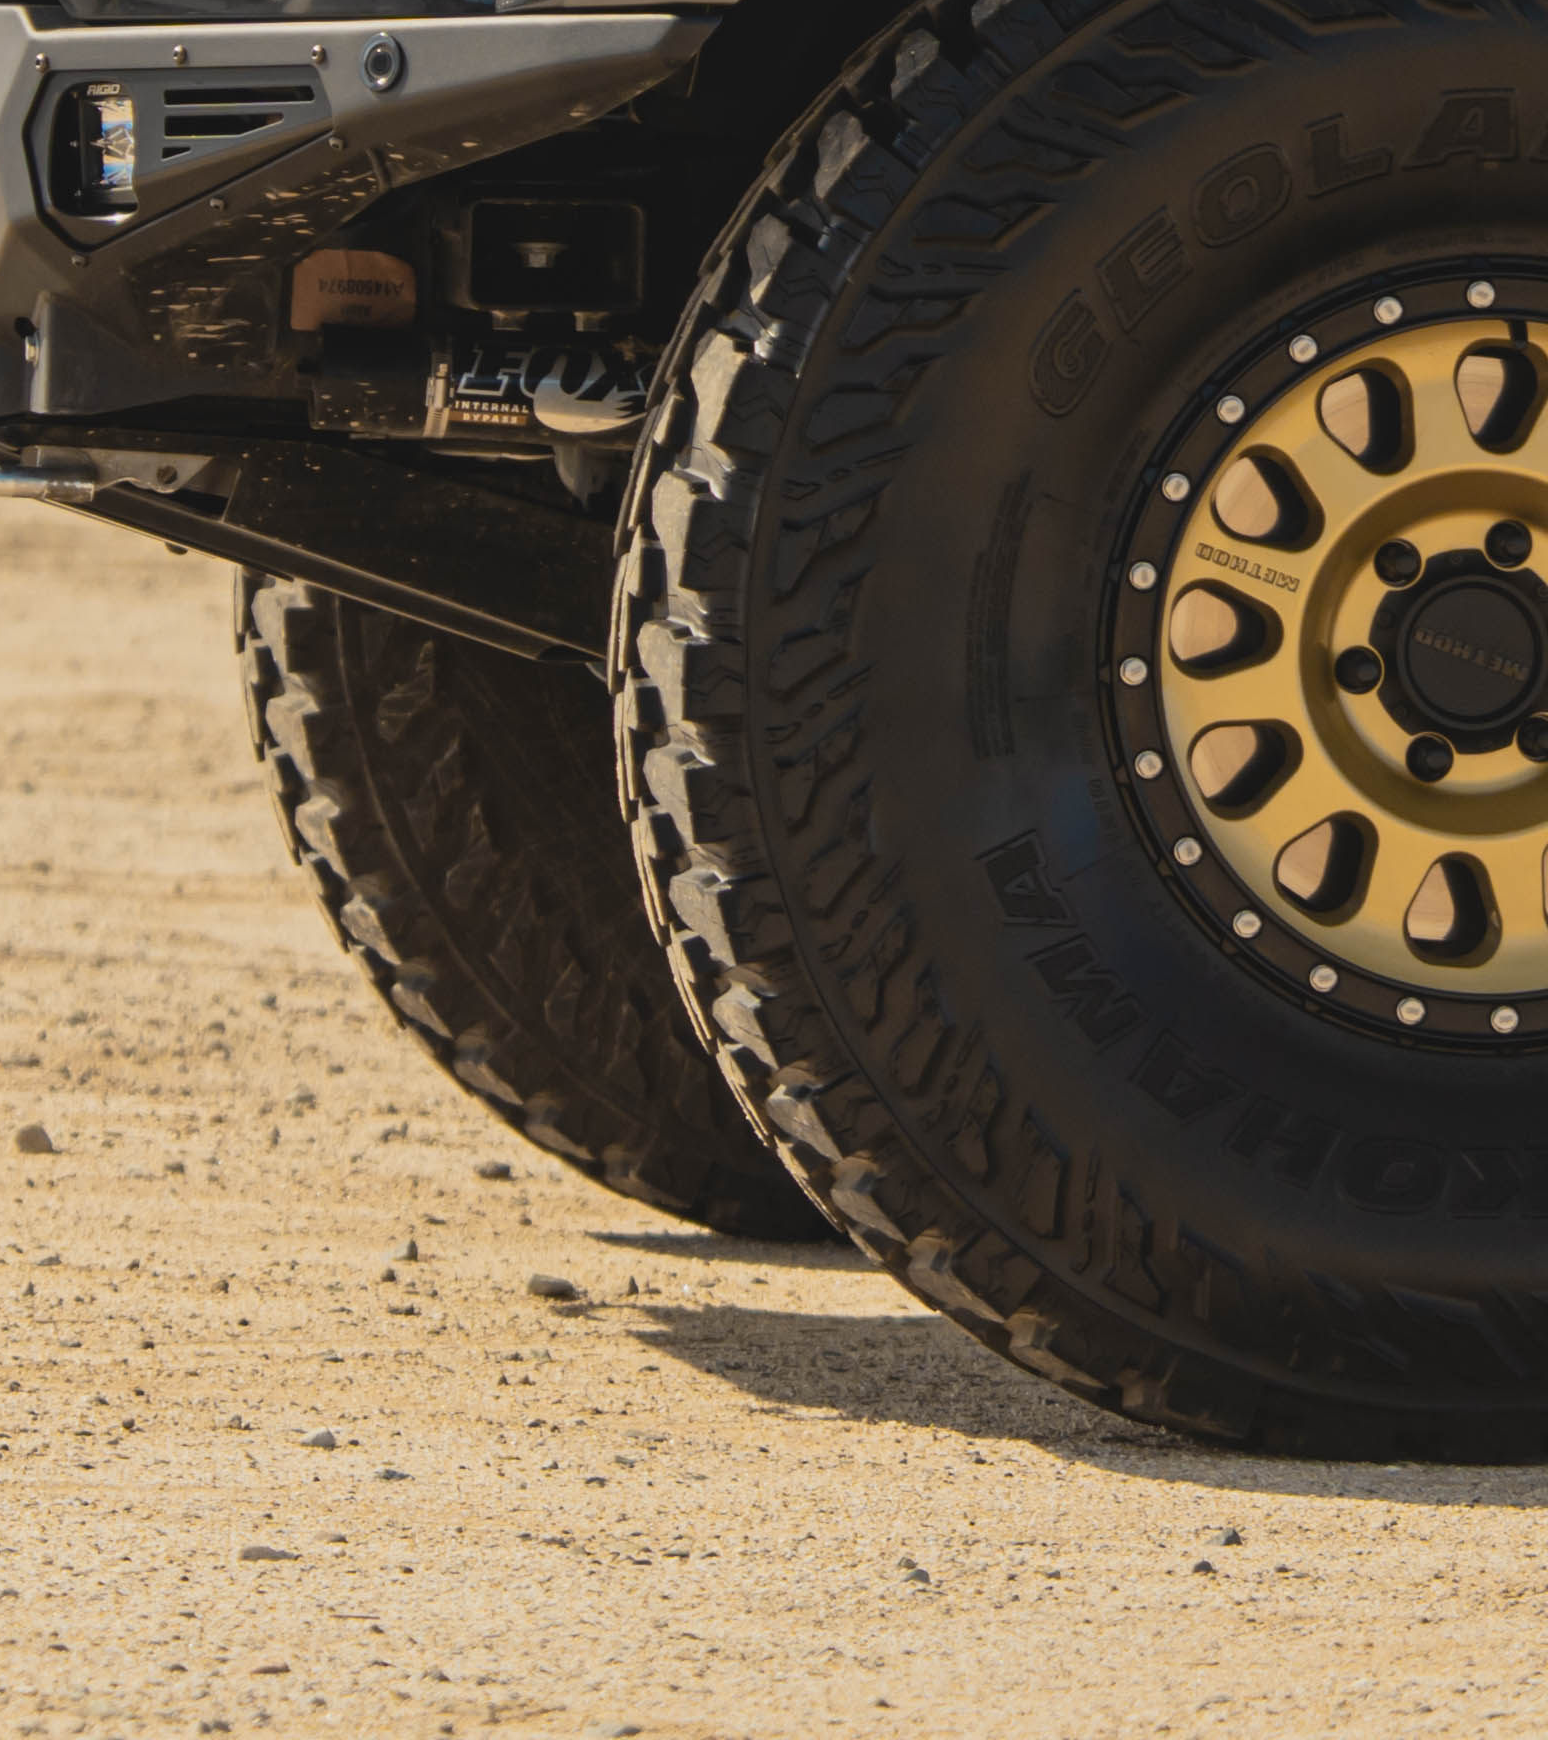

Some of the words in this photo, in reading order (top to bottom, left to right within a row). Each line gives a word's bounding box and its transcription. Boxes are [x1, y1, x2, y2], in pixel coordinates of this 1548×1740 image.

[86, 83, 121, 97] RIGID
[456, 342, 649, 404] FOX
[454, 399, 530, 414] INTERNAL
[462, 412, 519, 425] BYPASS
[1194, 541, 1301, 593] METHOD
[1414, 626, 1530, 682] METHOD
